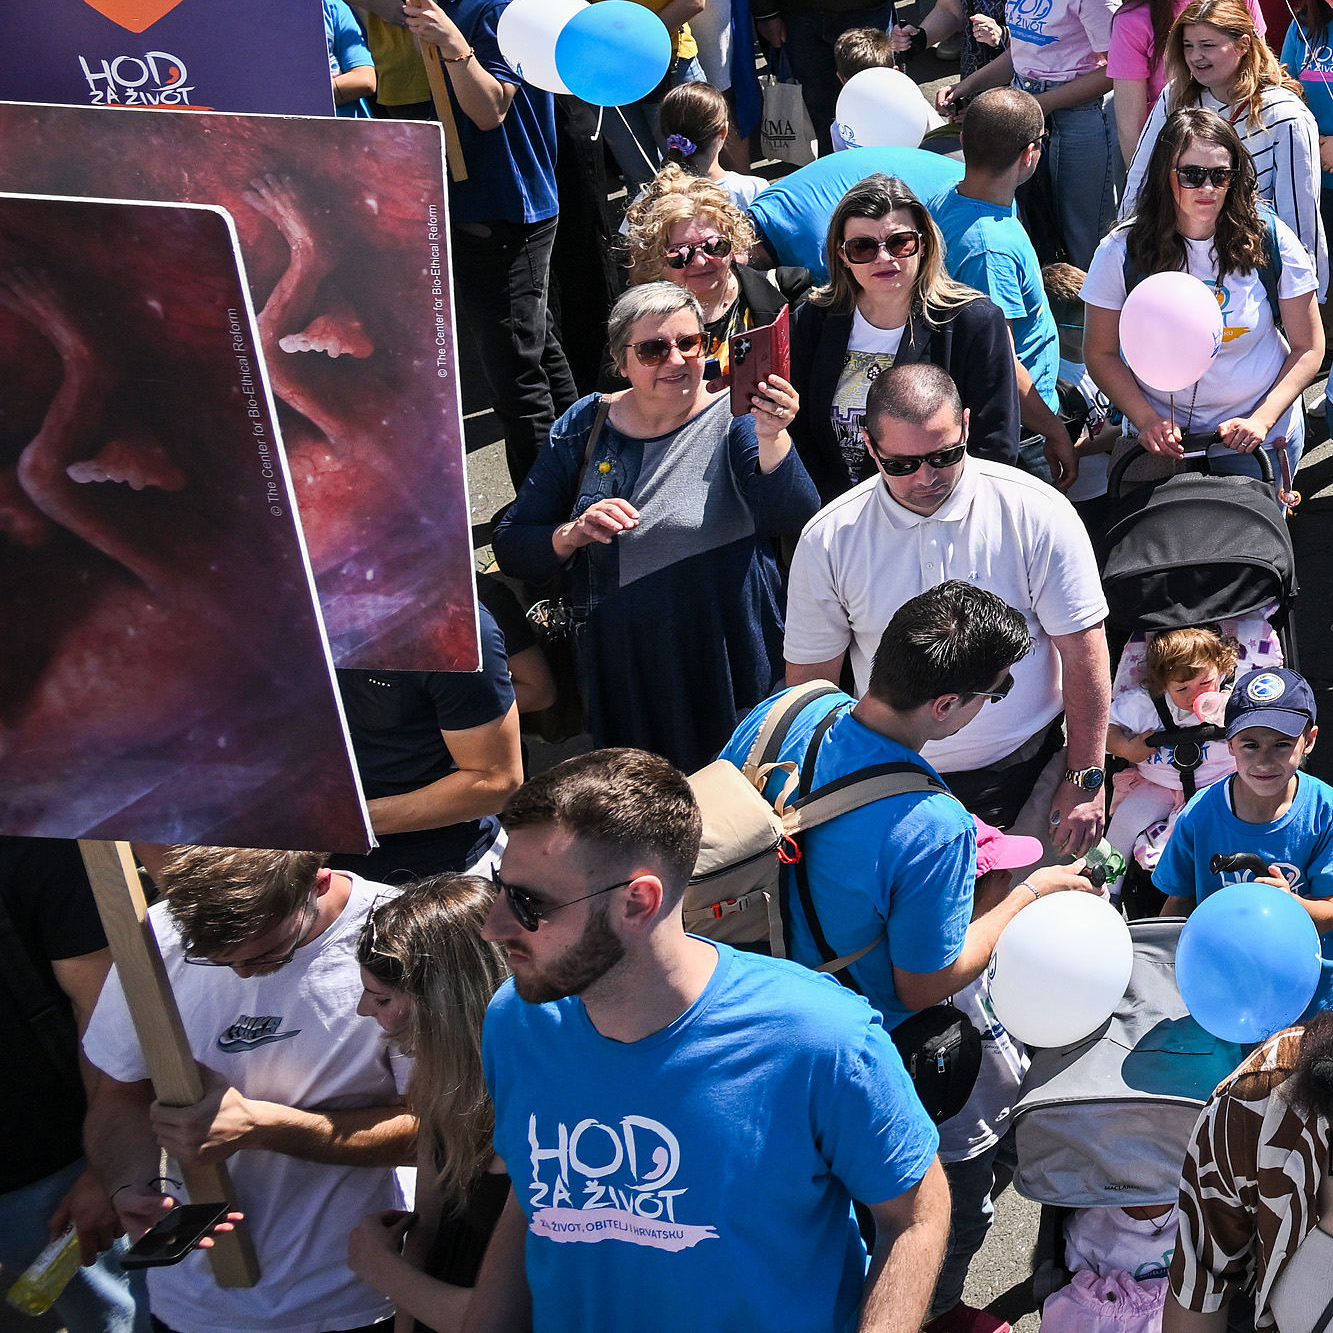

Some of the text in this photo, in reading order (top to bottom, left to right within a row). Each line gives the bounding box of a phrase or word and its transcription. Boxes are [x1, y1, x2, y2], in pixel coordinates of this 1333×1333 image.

[80, 51, 188, 93] HOD
[90, 86, 196, 106] ZA ŽIVOT
[428, 203, 447, 368] The Center for Bio-Ethical Reform
[227, 308, 279, 503] The Center for Bio-Ethical Reform
[528, 1111, 681, 1191] HOD
[528, 1173, 689, 1224] ZA ŽIVOT
[585, 1219, 684, 1240] OBITELJ HRVATSKU
